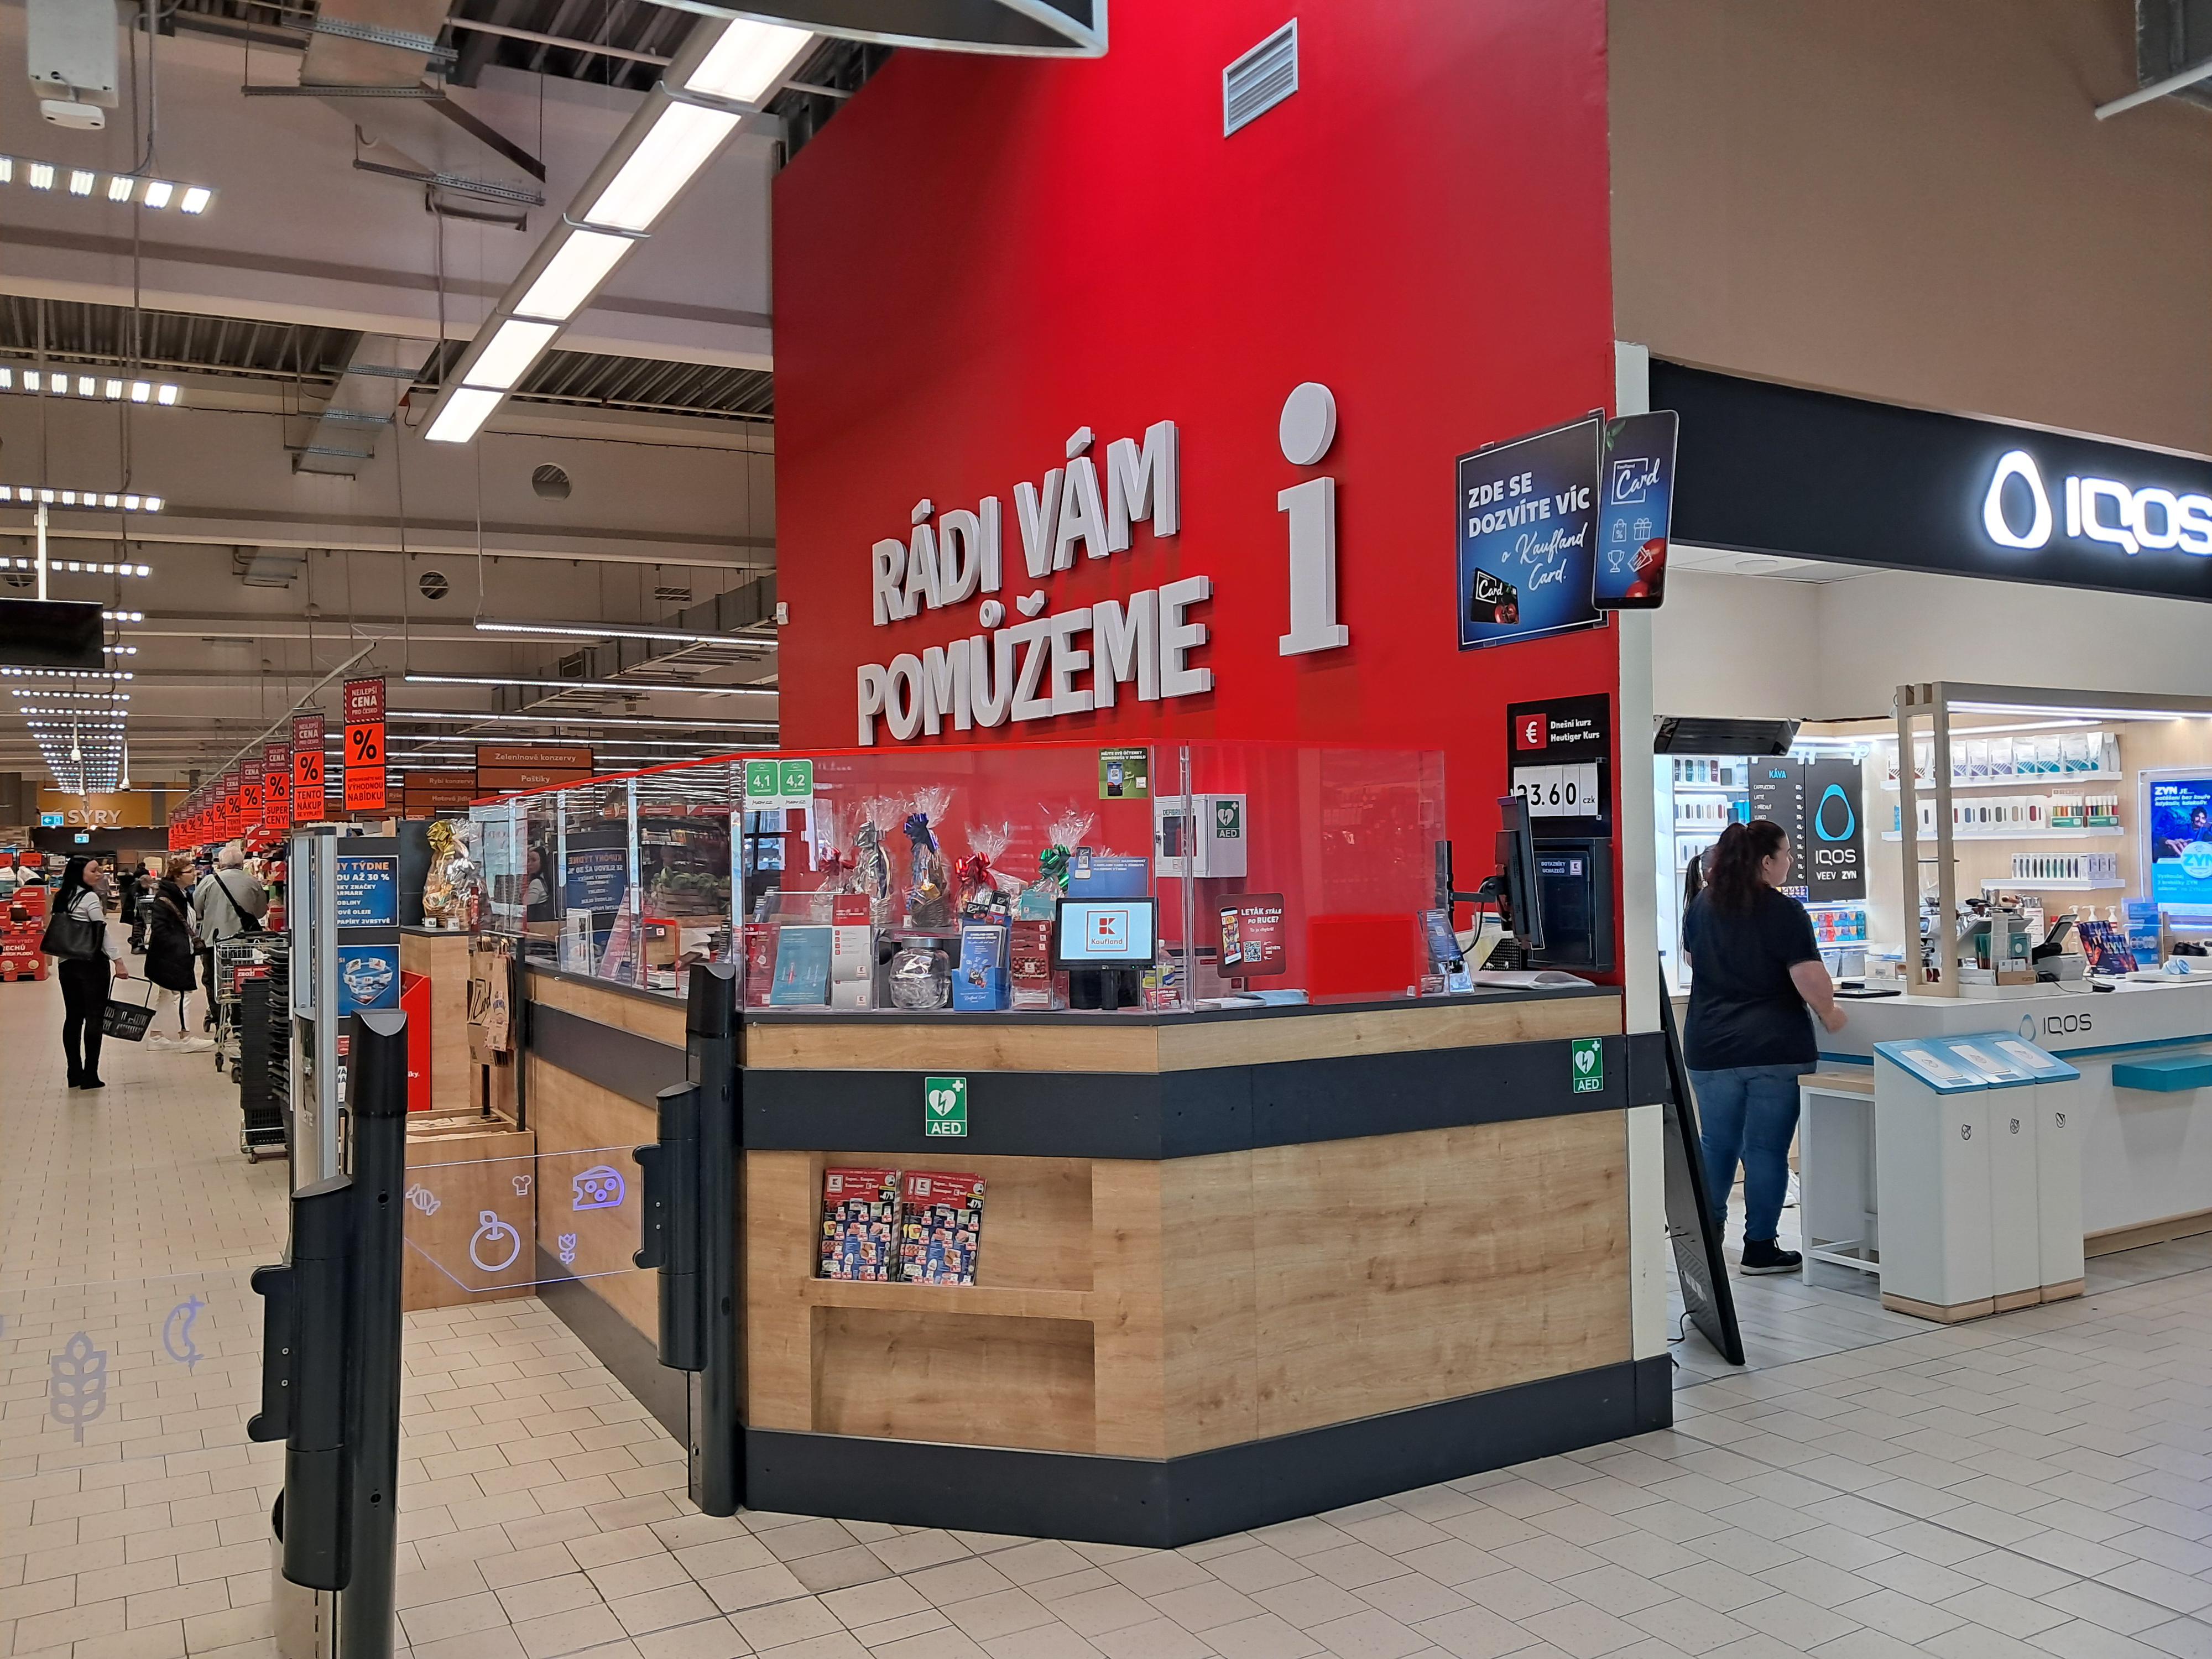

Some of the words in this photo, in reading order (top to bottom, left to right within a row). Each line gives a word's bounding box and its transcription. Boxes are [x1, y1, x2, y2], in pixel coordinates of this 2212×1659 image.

[1615, 457, 1660, 500] Card
[1469, 480, 1504, 509] ZDE
[1509, 471, 1532, 497] SE
[1469, 498, 1551, 538] DOZVÍTE
[1555, 484, 1590, 515] VÍC
[2064, 476, 2212, 556] IQOS
[872, 496, 1002, 627] RÁDI
[1013, 420, 1179, 578] VÁM
[1515, 521, 1588, 565] Kaufland
[1528, 559, 1567, 591] Card.
[1478, 579, 1504, 598] Card
[857, 575, 1214, 746] POMŮŽEME
[352, 686, 377, 696] NEJLEPŠÍ
[352, 695, 377, 708] CENA
[1550, 719, 1574, 729] Dnešní
[299, 729, 319, 738] CENA
[1525, 721, 1538, 743] €
[1550, 733, 1582, 742] Heutiger
[1583, 731, 1600, 739] Kurs
[353, 729, 377, 760] %
[540, 753, 576, 763] konzervy
[300, 756, 319, 781] %
[1769, 768, 1787, 779] KÁVA
[521, 775, 550, 784] Paštiky
[753, 775, 770, 788] 4,1
[786, 774, 805, 787] 4,2
[270, 776, 285, 796] %
[348, 782, 383, 790] VÝHODNOU
[2154, 786, 2178, 795] ZYN
[244, 787, 258, 806] %
[297, 790, 321, 799] TENTO
[348, 791, 383, 801] NABÍDKU!
[1583, 795, 1596, 804] czk
[228, 797, 241, 813] %
[267, 806, 288, 815] SUPER
[297, 800, 321, 810] NÁKUP
[266, 816, 288, 825] CENY!
[1219, 829, 1237, 837] AED
[1815, 849, 1856, 865] IQOS
[352, 860, 389, 870] TÝDNE
[1816, 871, 1837, 880] VEEV
[1841, 870, 1857, 879] ZYN
[1241, 906, 1264, 916] LETÁK
[2043, 1014, 2092, 1036] IQOS
[1577, 1079, 1599, 1091] AED
[931, 1122, 961, 1134] AED
[879, 1191, 894, 1201] -47%
